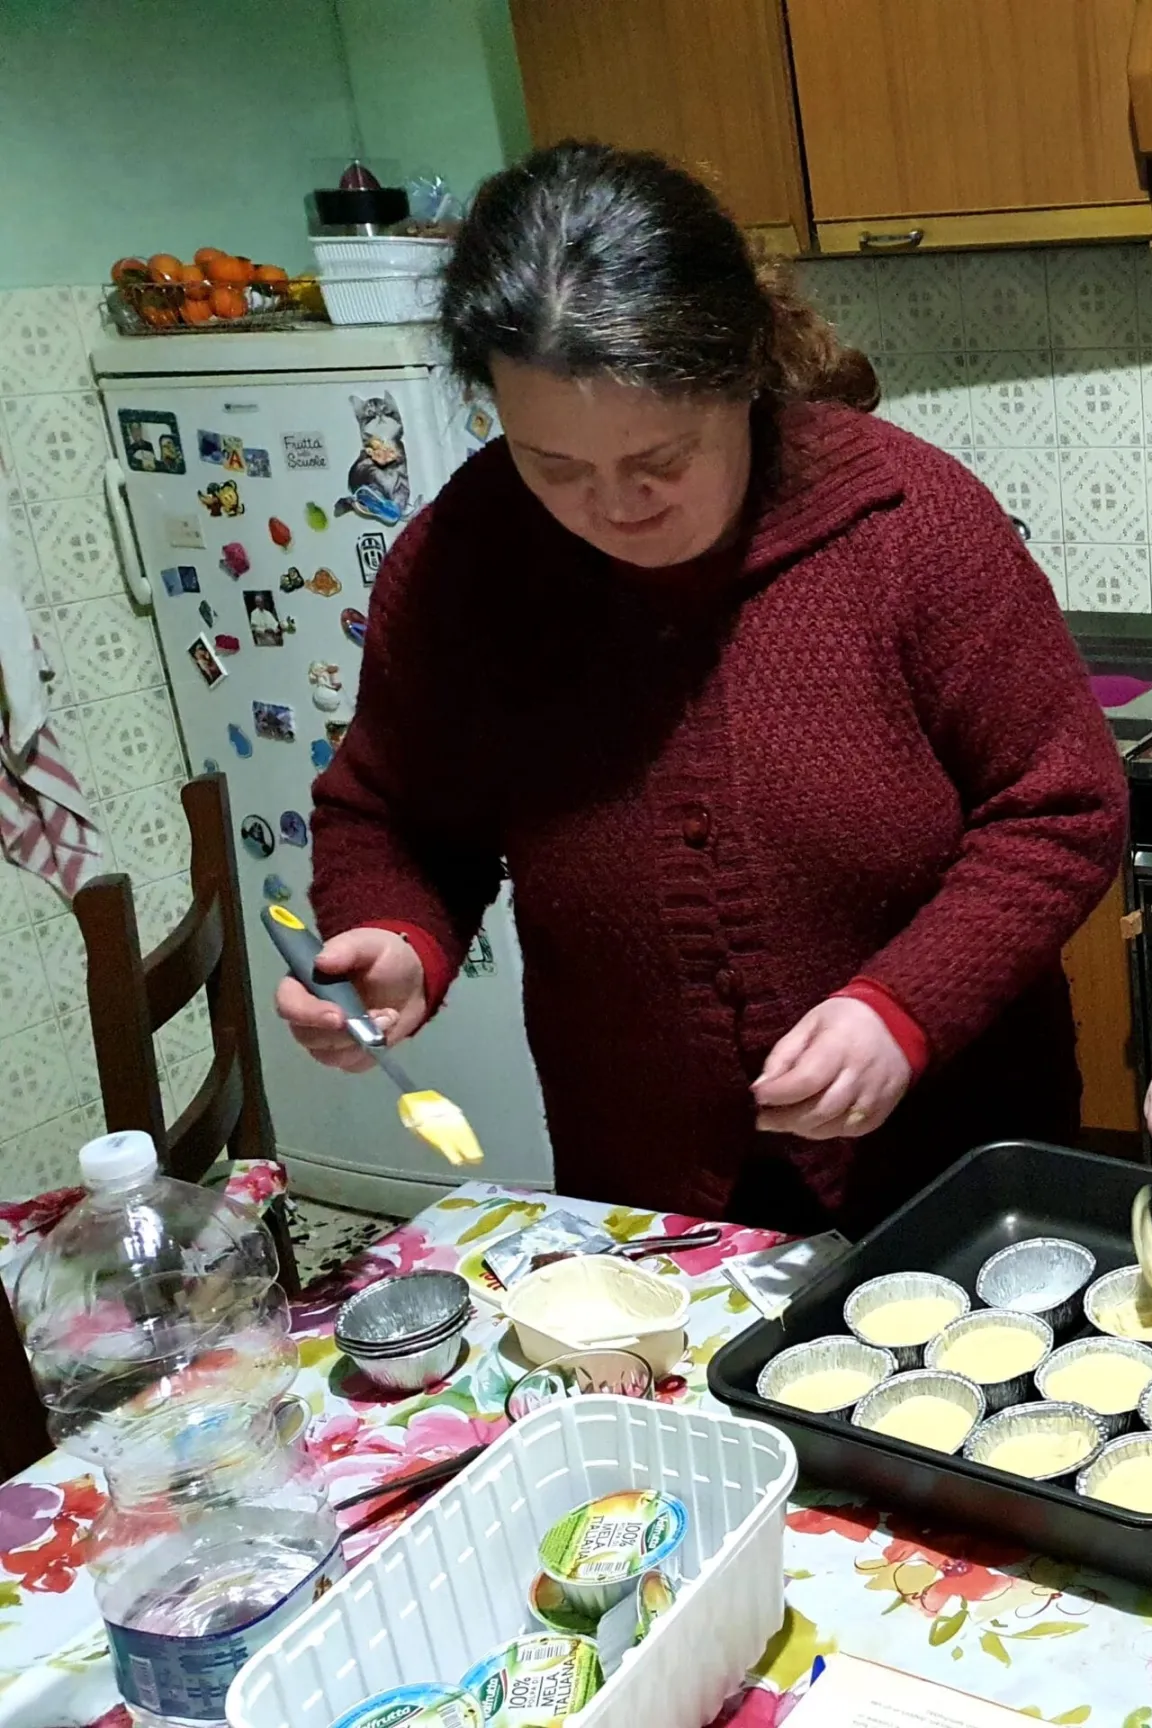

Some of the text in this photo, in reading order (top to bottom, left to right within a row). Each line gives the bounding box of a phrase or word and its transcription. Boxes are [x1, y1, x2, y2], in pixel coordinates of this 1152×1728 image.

[576, 1515, 605, 1561] ITALIANA
[593, 1523, 614, 1551] MELA
[619, 1522, 642, 1548] 100%
[508, 1677, 532, 1710] 100%
[541, 1672, 560, 1707] MELA
[554, 1657, 577, 1717] ITALIANA
